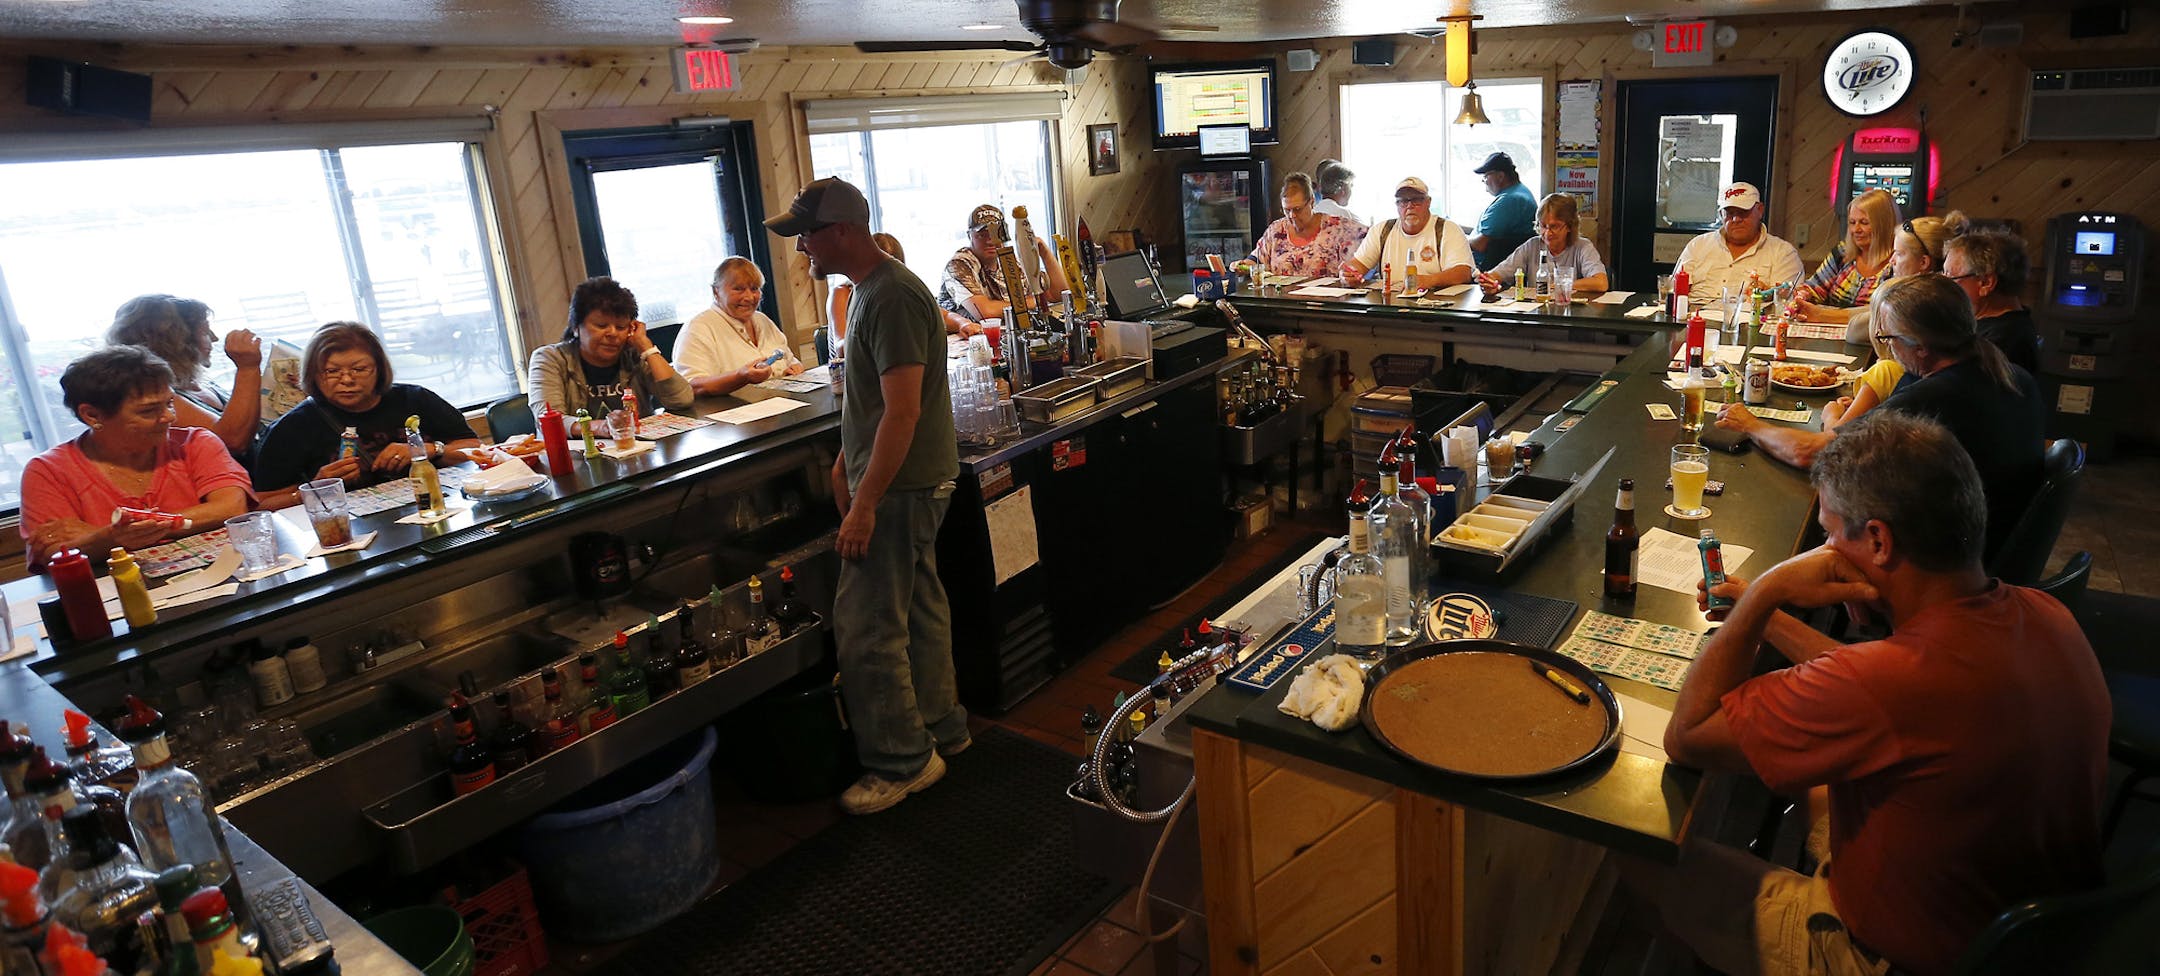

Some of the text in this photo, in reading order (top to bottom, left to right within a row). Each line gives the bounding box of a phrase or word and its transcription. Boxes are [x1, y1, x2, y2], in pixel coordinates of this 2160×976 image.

[1664, 22, 1707, 54] EXIT
[685, 50, 732, 91] EXIT
[1849, 65, 1891, 89] Lite
[1568, 170, 1586, 179] Now
[1558, 180, 1596, 189] Available!
[2079, 215, 2116, 223] ATM
